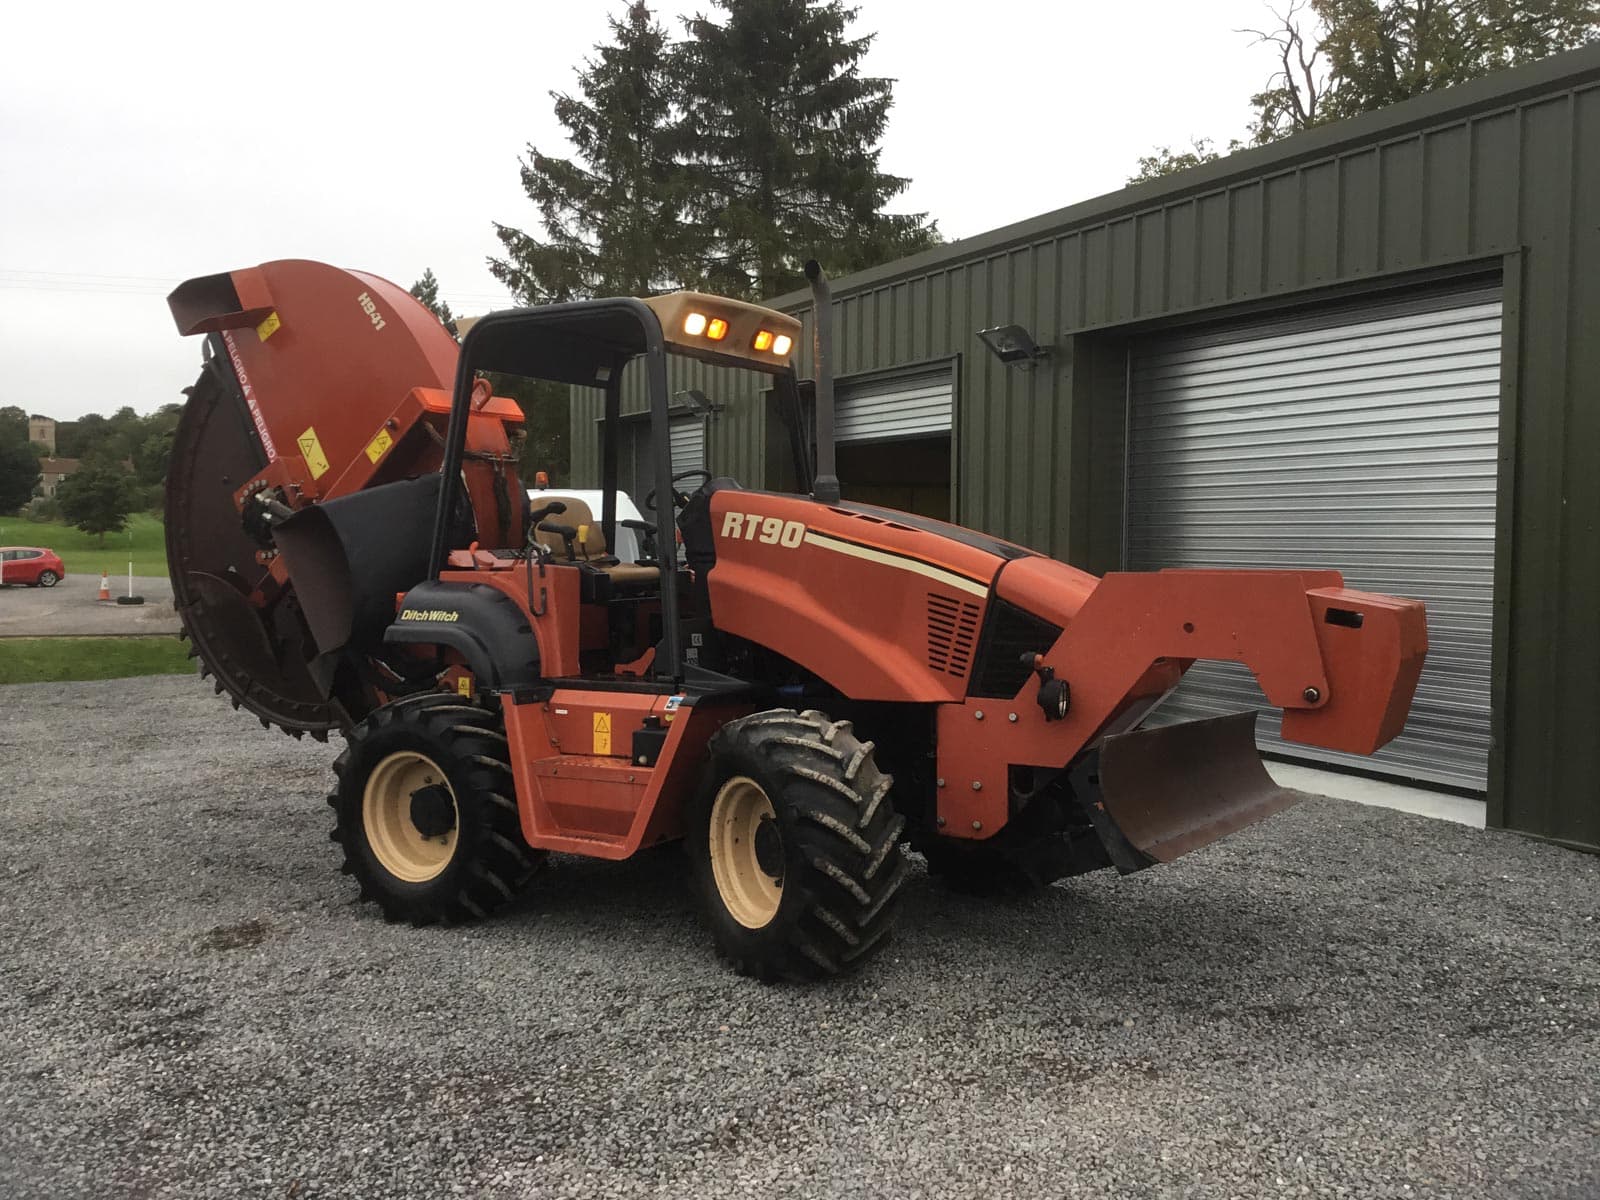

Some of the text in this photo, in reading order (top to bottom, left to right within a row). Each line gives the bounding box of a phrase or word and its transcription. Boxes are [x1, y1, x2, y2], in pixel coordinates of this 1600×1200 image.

[357, 291, 387, 331] H941
[224, 335, 276, 459] PELIGRO PELIGRO
[720, 511, 806, 549] RT90
